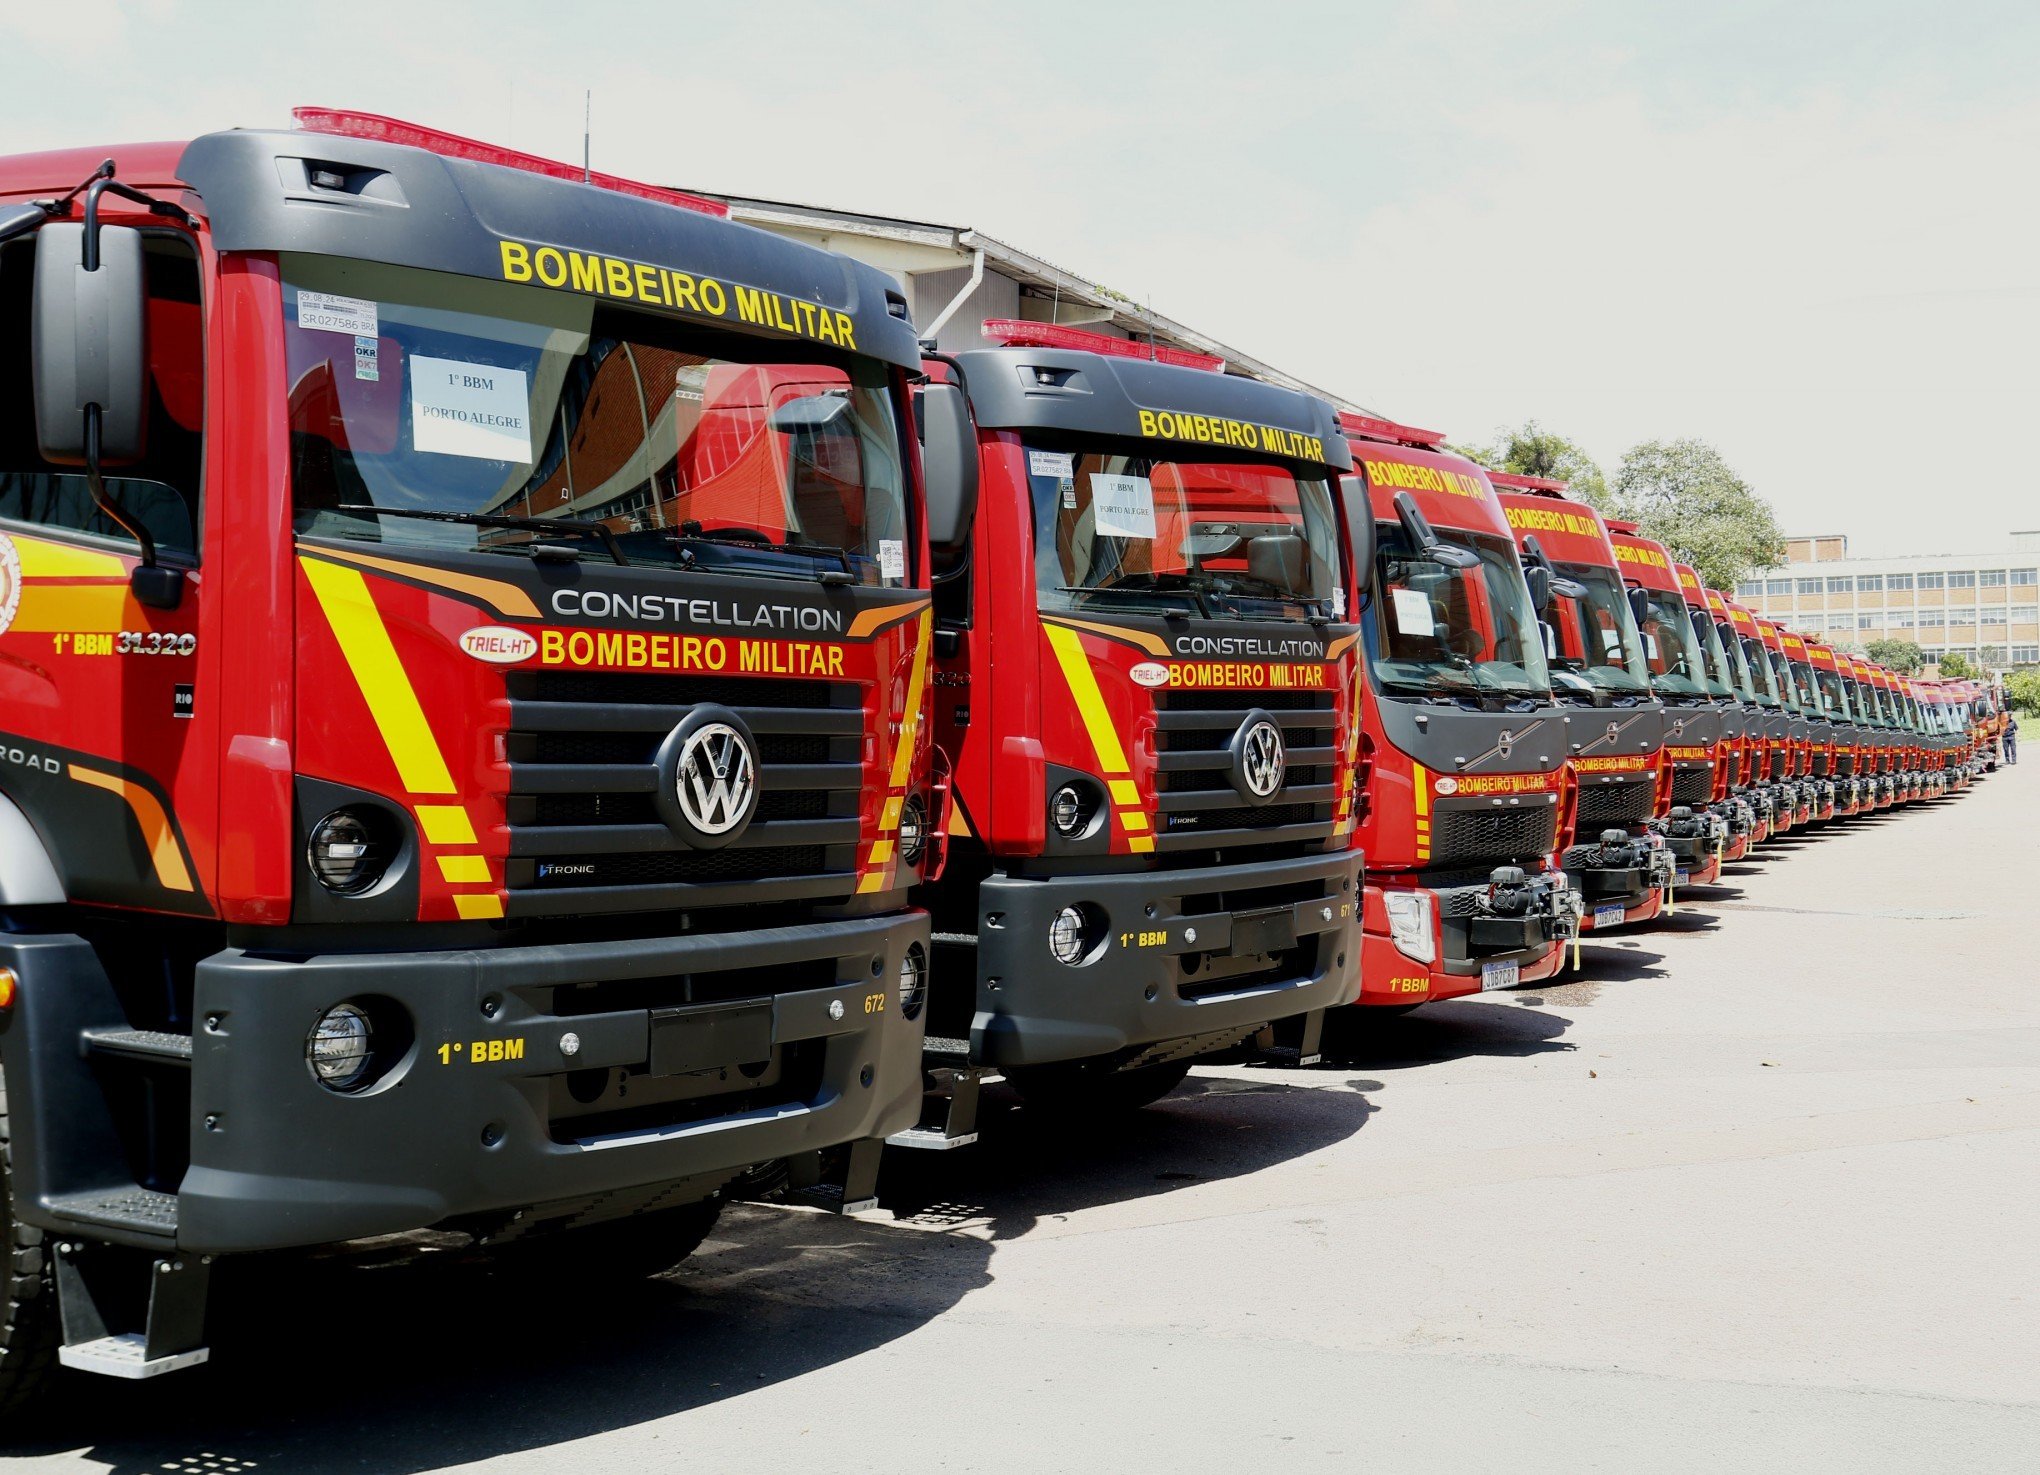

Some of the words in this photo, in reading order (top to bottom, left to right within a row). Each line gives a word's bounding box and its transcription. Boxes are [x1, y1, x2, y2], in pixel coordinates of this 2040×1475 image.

[499, 241, 727, 316] BOMBEIRO
[734, 285, 857, 351] MILITAR
[356, 347, 376, 357] OKR
[463, 375, 495, 391] BBM
[423, 405, 467, 422] PORTO
[470, 412, 522, 429] ALEGRE
[1138, 410, 1258, 449] BOMBEIRO
[1260, 425, 1326, 464] MILITAR
[1117, 483, 1135, 492] BBM
[1366, 460, 1444, 493] BOMBEIRO
[1439, 470, 1488, 502] MILITAR
[1100, 505, 1123, 514] PORTO
[1124, 507, 1149, 516] ALEGRE
[1505, 508, 1565, 532] BOMBEIRO
[1563, 514, 1601, 540] MILITAR
[551, 589, 842, 632] CONSTELLATION
[74, 633, 113, 656] BBM
[116, 631, 196, 656] 31.320
[466, 636, 531, 655] TRIEL-HT
[541, 630, 727, 671] BOMBEIRO
[739, 640, 844, 676] MILITAR
[1176, 636, 1323, 657] CONSTELLATION
[1133, 669, 1167, 681] TRIEL-HT
[1169, 664, 1264, 687] BOMBEIRO
[1269, 665, 1322, 687] MILITAR
[175, 693, 193, 705] RIO
[1574, 758, 1616, 772] BOMBEIRO
[1618, 757, 1645, 770] MILITAR
[1458, 777, 1510, 794] BOMBEIRO
[1513, 775, 1546, 791] MILITAR
[1340, 903, 1351, 918] 671
[1138, 930, 1167, 947] BBM
[1402, 978, 1429, 992] BBM
[864, 993, 885, 1014] 672
[471, 1038, 524, 1062] BBM
